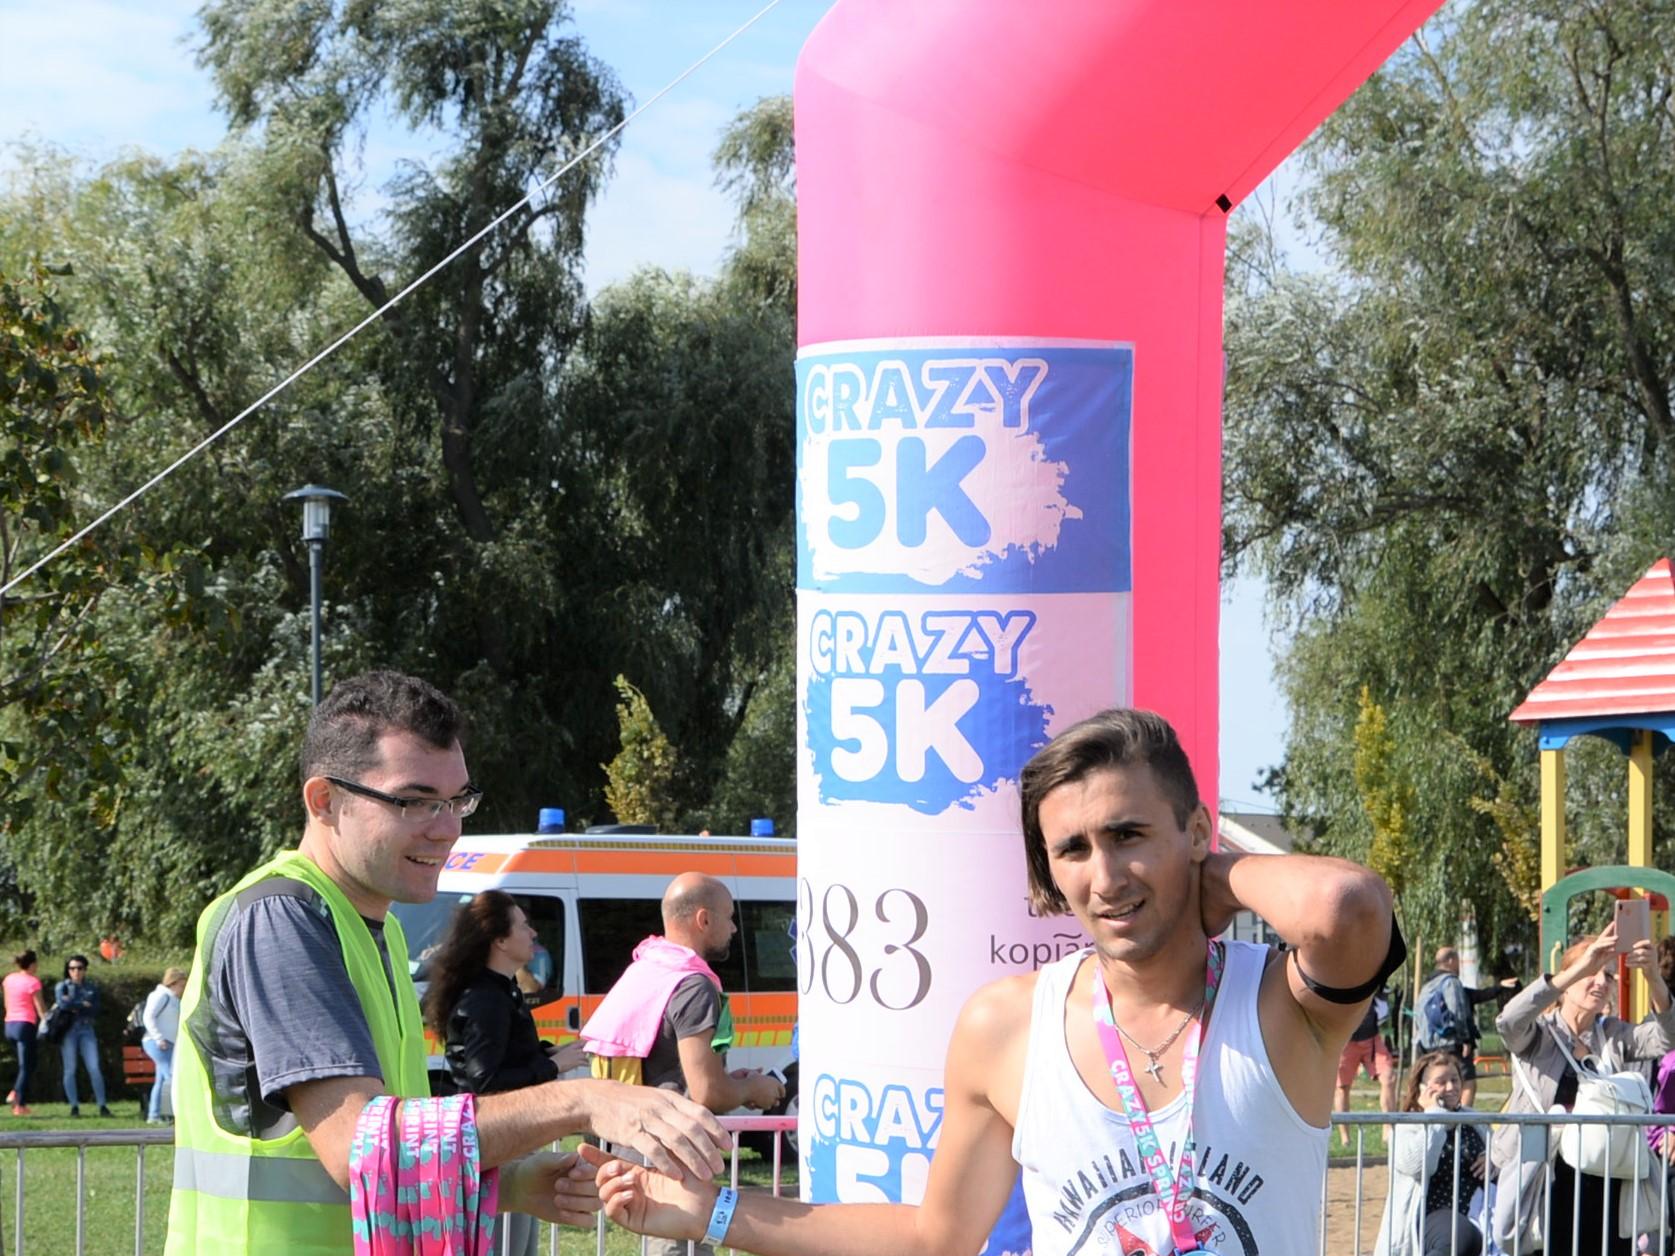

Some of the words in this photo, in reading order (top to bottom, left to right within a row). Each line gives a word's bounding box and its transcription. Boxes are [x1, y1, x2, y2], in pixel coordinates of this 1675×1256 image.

[805, 358, 1048, 437] CRAZY
[828, 435, 991, 550] 5K
[810, 609, 1036, 679] CRAZY
[831, 678, 984, 783] 5K
[835, 1143, 930, 1206] 5
[1054, 1139, 1146, 1235] HAWAIIA
[1169, 1141, 1264, 1205] ILAND
[1146, 1152, 1176, 1214] SPRIN
